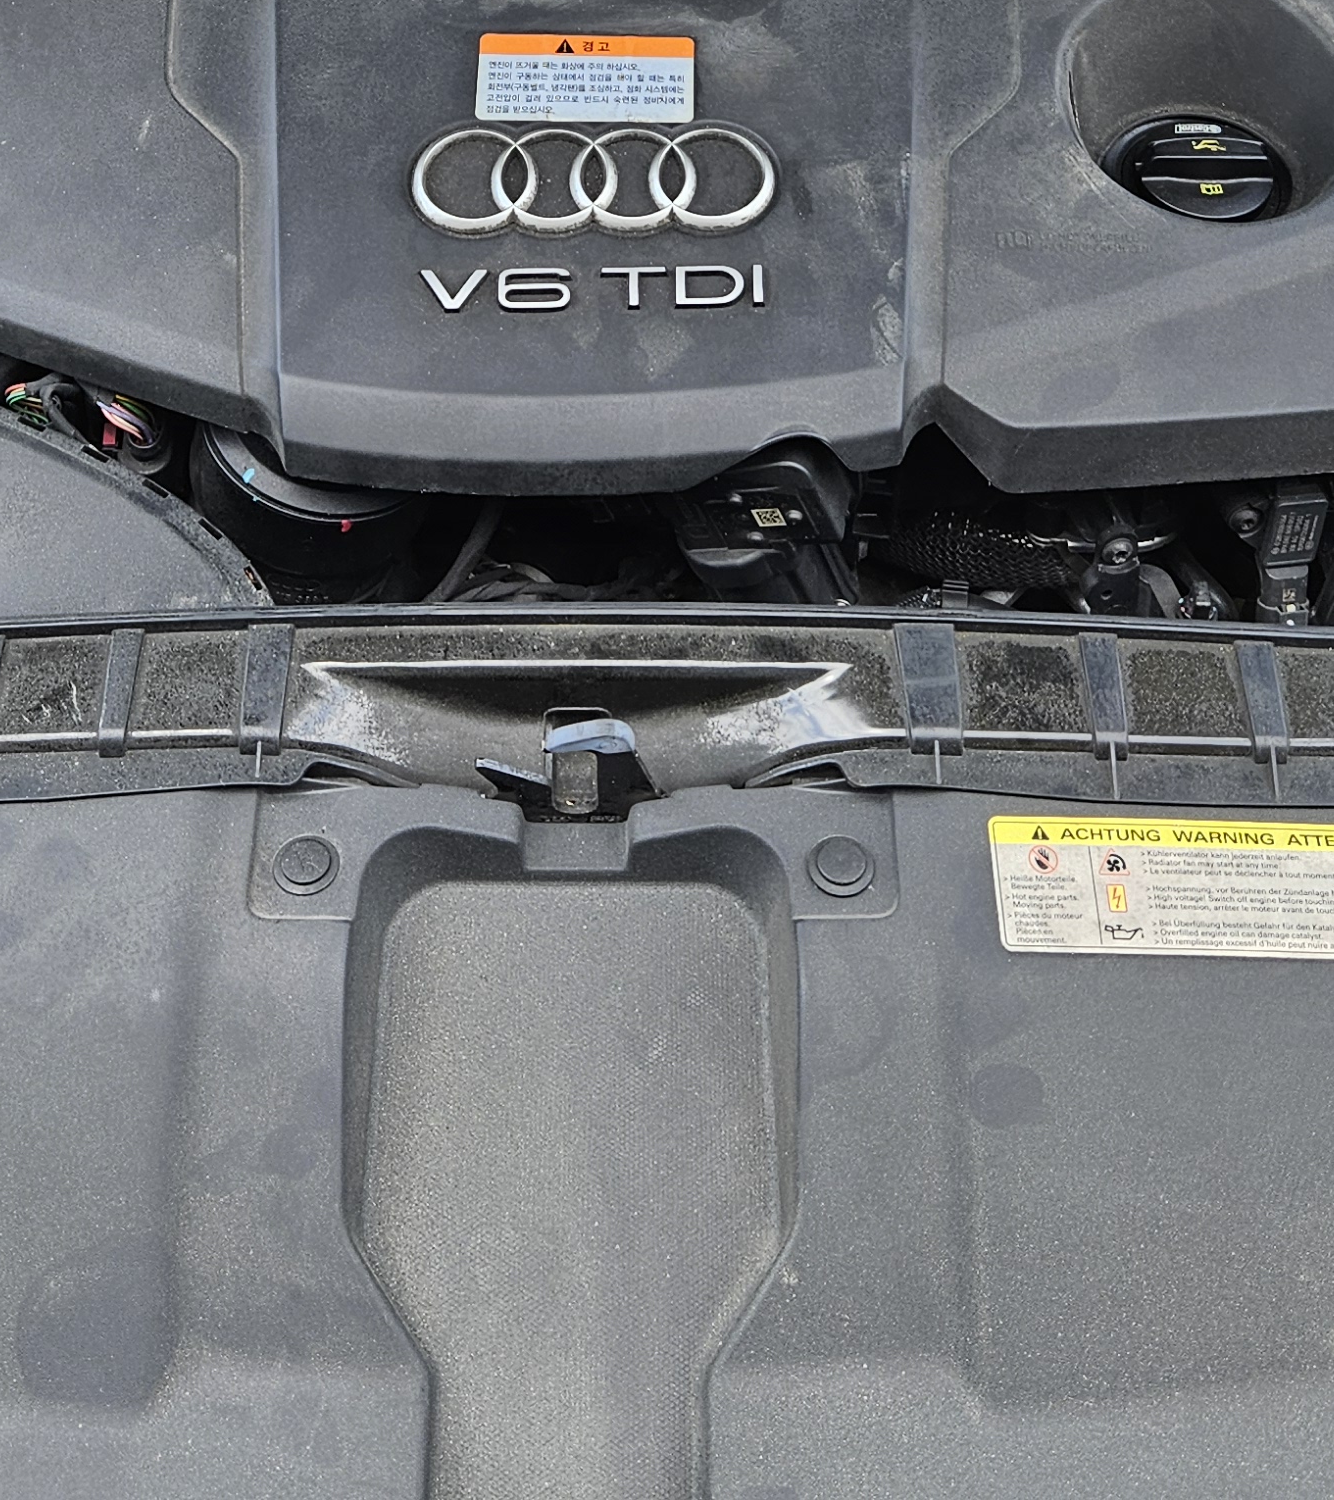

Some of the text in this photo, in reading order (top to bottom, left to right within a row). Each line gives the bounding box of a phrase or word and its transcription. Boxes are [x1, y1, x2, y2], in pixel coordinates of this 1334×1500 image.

[582, 41, 610, 53] 경고
[420, 264, 764, 312] V6 TDI
[1061, 827, 1161, 842] ACHTUNG
[1172, 829, 1275, 846] WARNING
